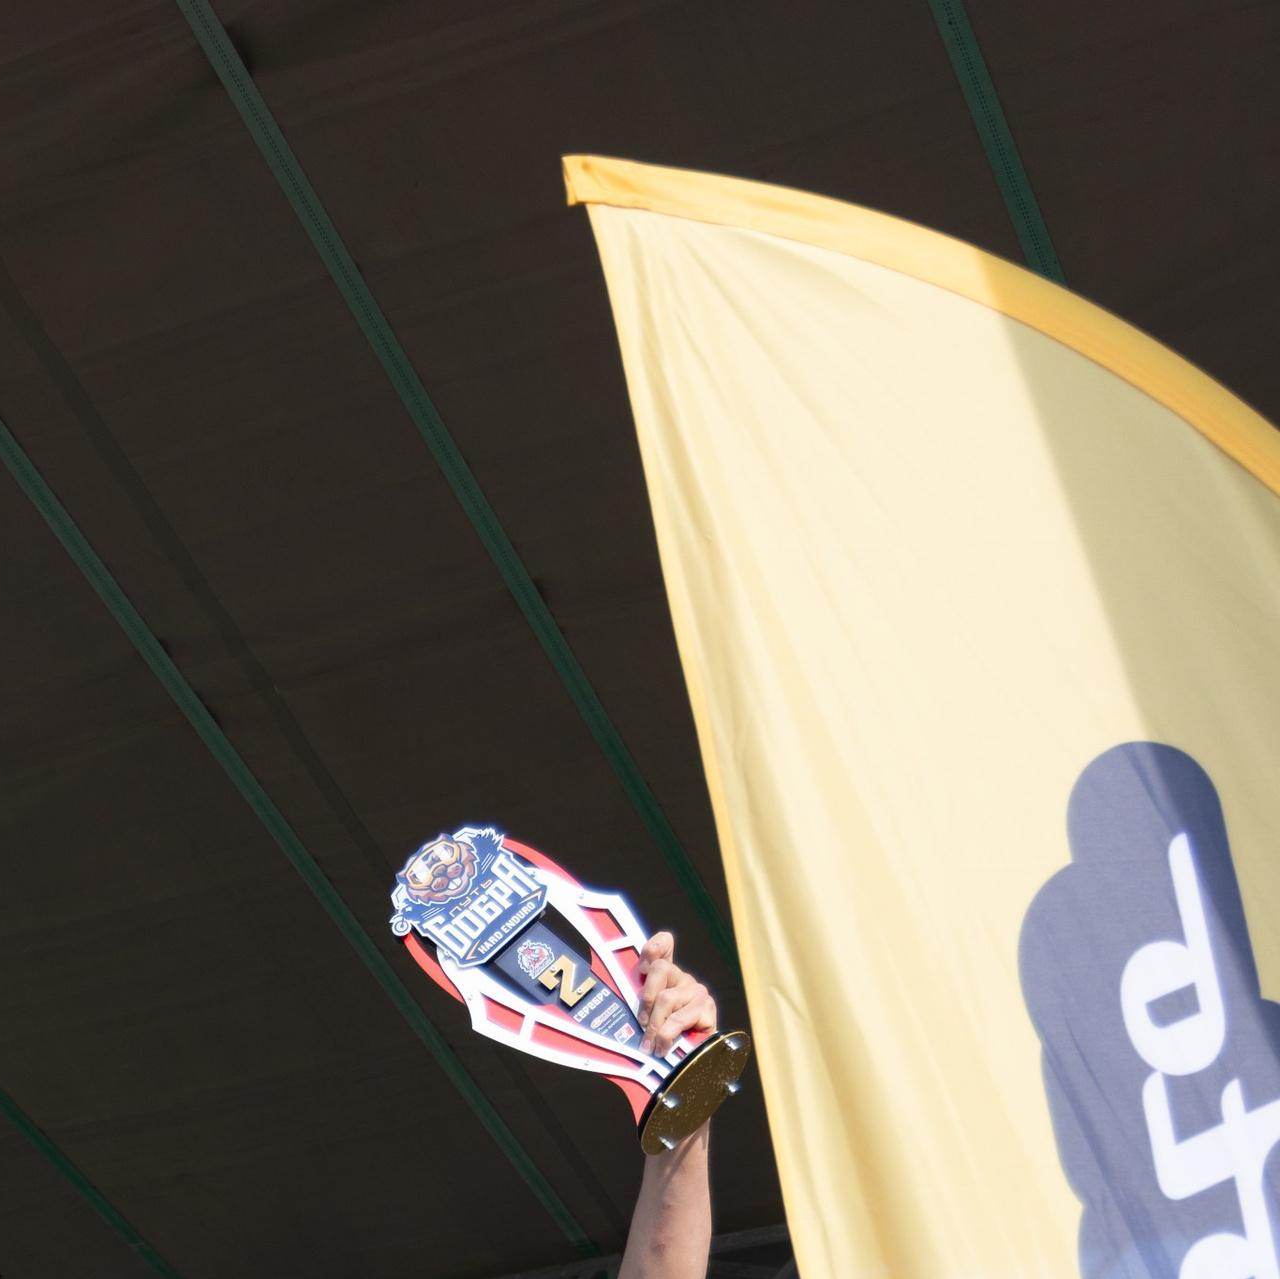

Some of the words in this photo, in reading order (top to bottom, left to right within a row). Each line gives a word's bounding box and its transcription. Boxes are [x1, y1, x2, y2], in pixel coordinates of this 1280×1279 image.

[423, 853, 541, 959] БОБРА
[449, 879, 493, 918] ПУТЬ
[478, 932, 503, 955] HARD
[503, 901, 536, 933] ENDURO
[537, 954, 597, 1008] 2
[573, 988, 610, 1023] СЕРЕБРО
